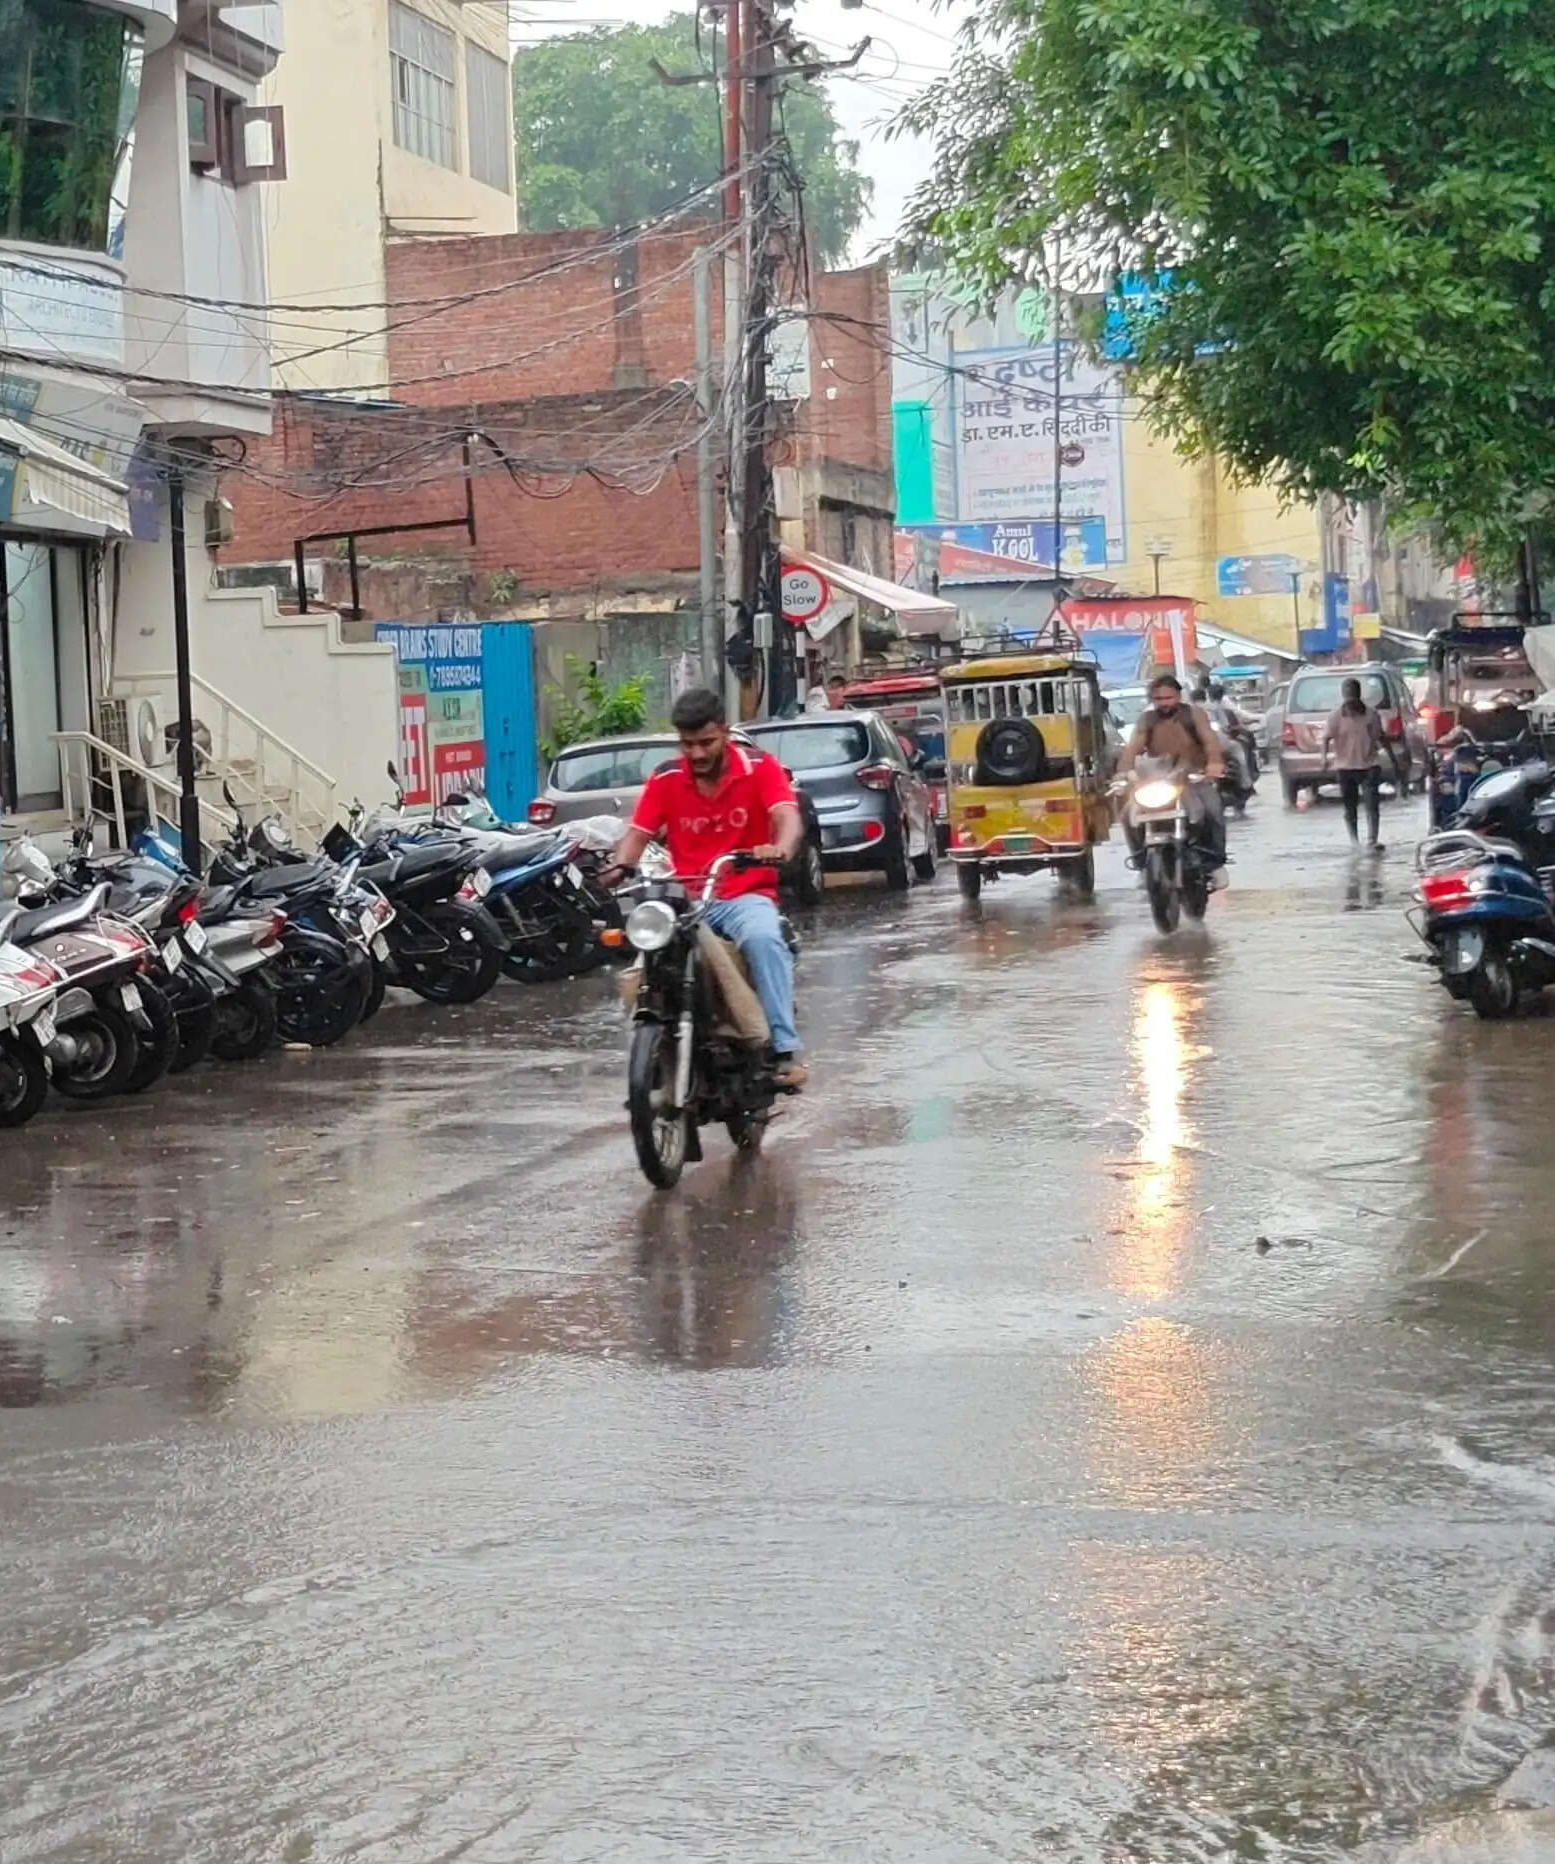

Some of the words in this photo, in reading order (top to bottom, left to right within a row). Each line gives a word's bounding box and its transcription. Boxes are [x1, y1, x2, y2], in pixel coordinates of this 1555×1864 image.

[993, 525, 1032, 538] Amul
[992, 537, 1038, 561] KOOL
[789, 578, 809, 591] Go
[783, 593, 817, 606] Slow
